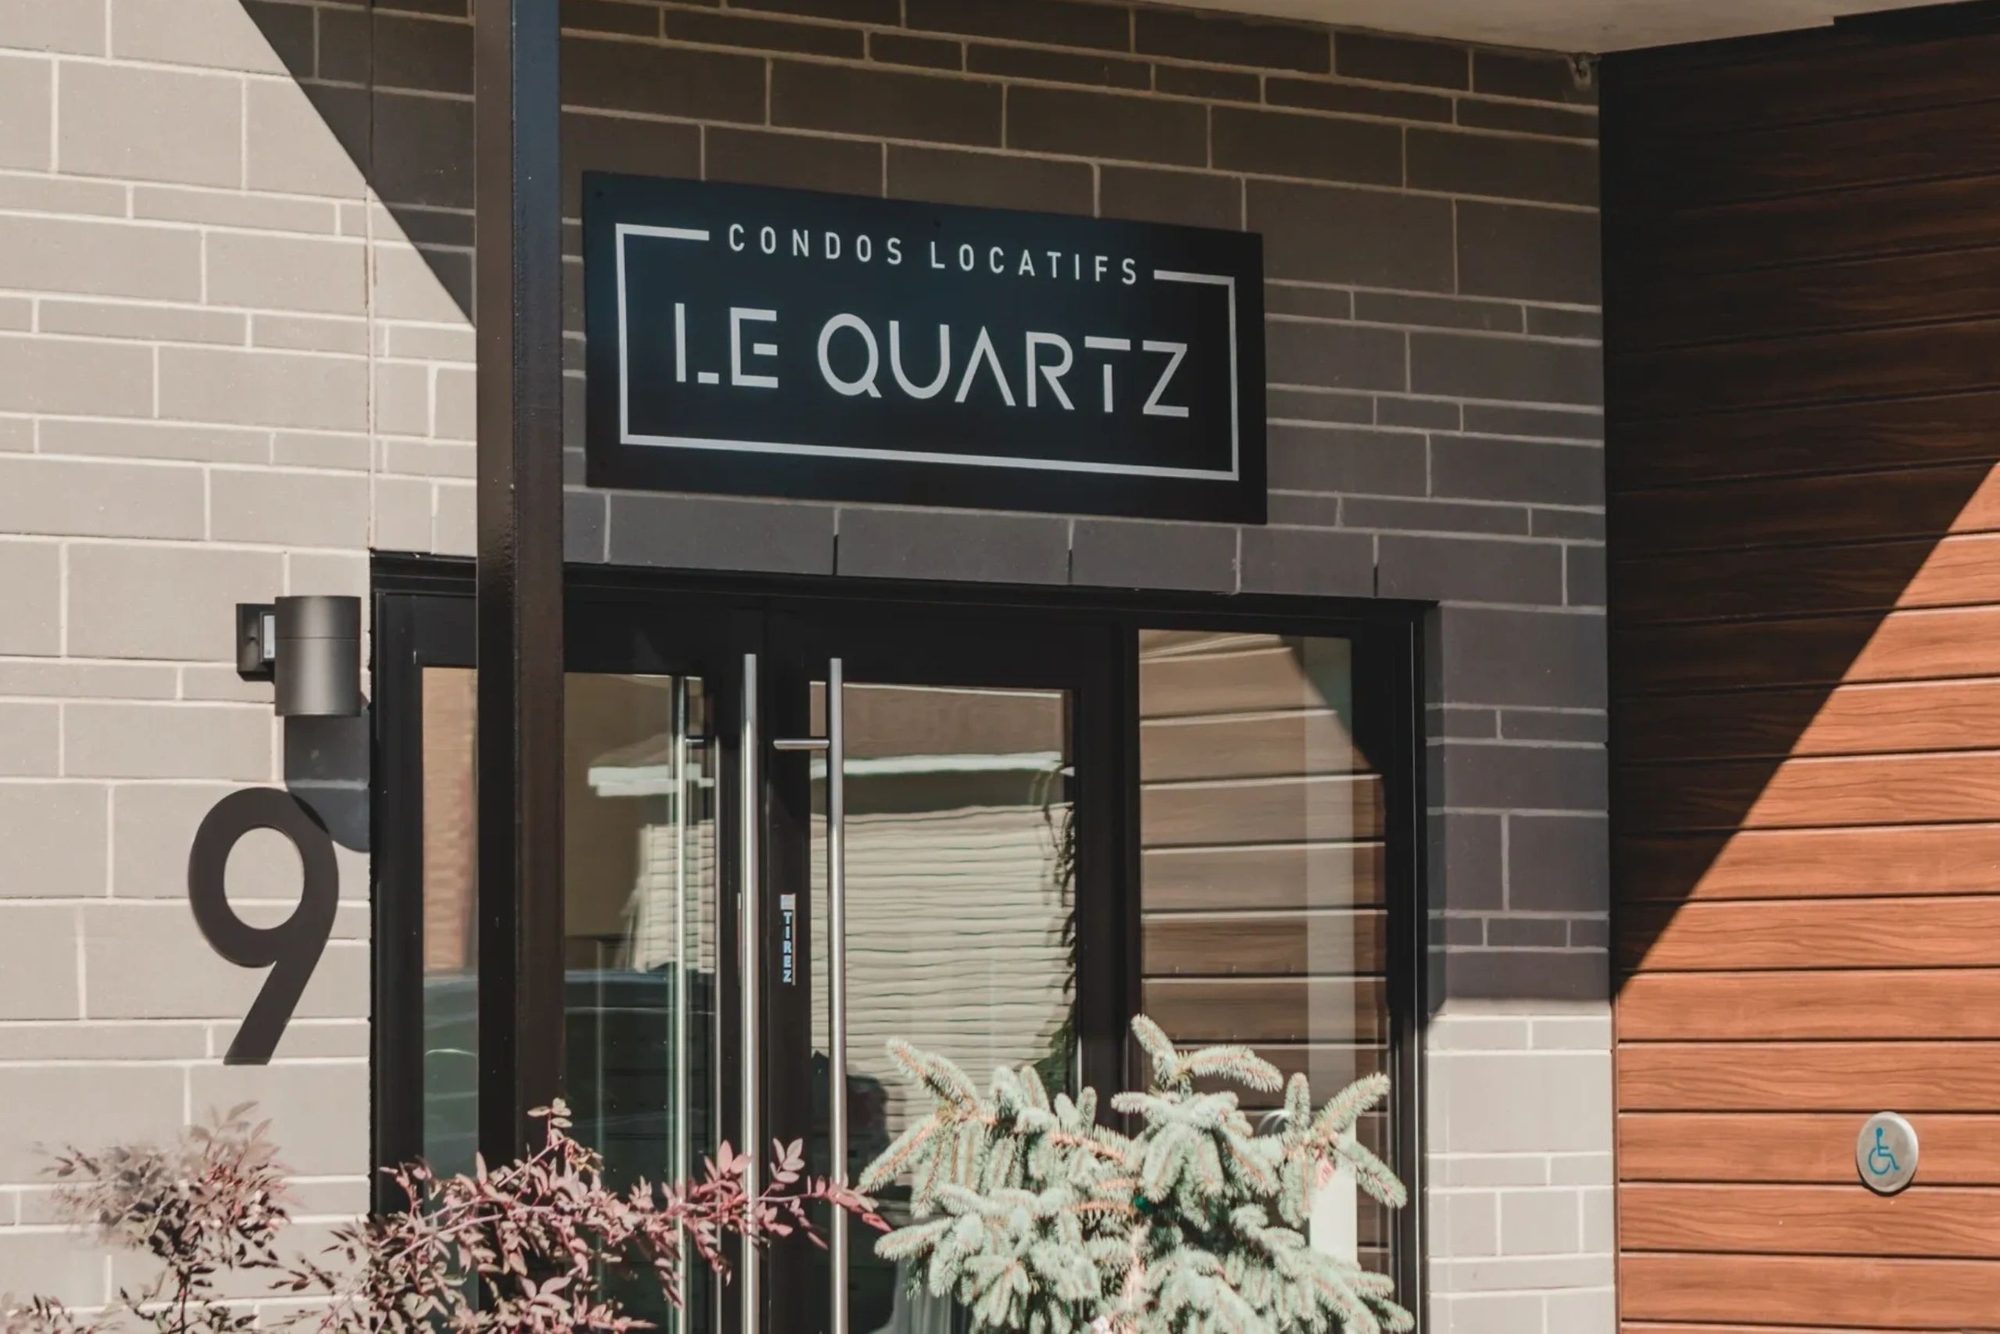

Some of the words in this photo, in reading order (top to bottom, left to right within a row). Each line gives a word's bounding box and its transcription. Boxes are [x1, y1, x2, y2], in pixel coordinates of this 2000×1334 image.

[728, 222, 903, 265] CONDOS
[930, 241, 1138, 285] LOCATIFS
[674, 302, 779, 388] LE
[817, 312, 1190, 418] QUARTZ
[188, 787, 339, 1065] 9
[782, 911, 793, 983] TIREZ
